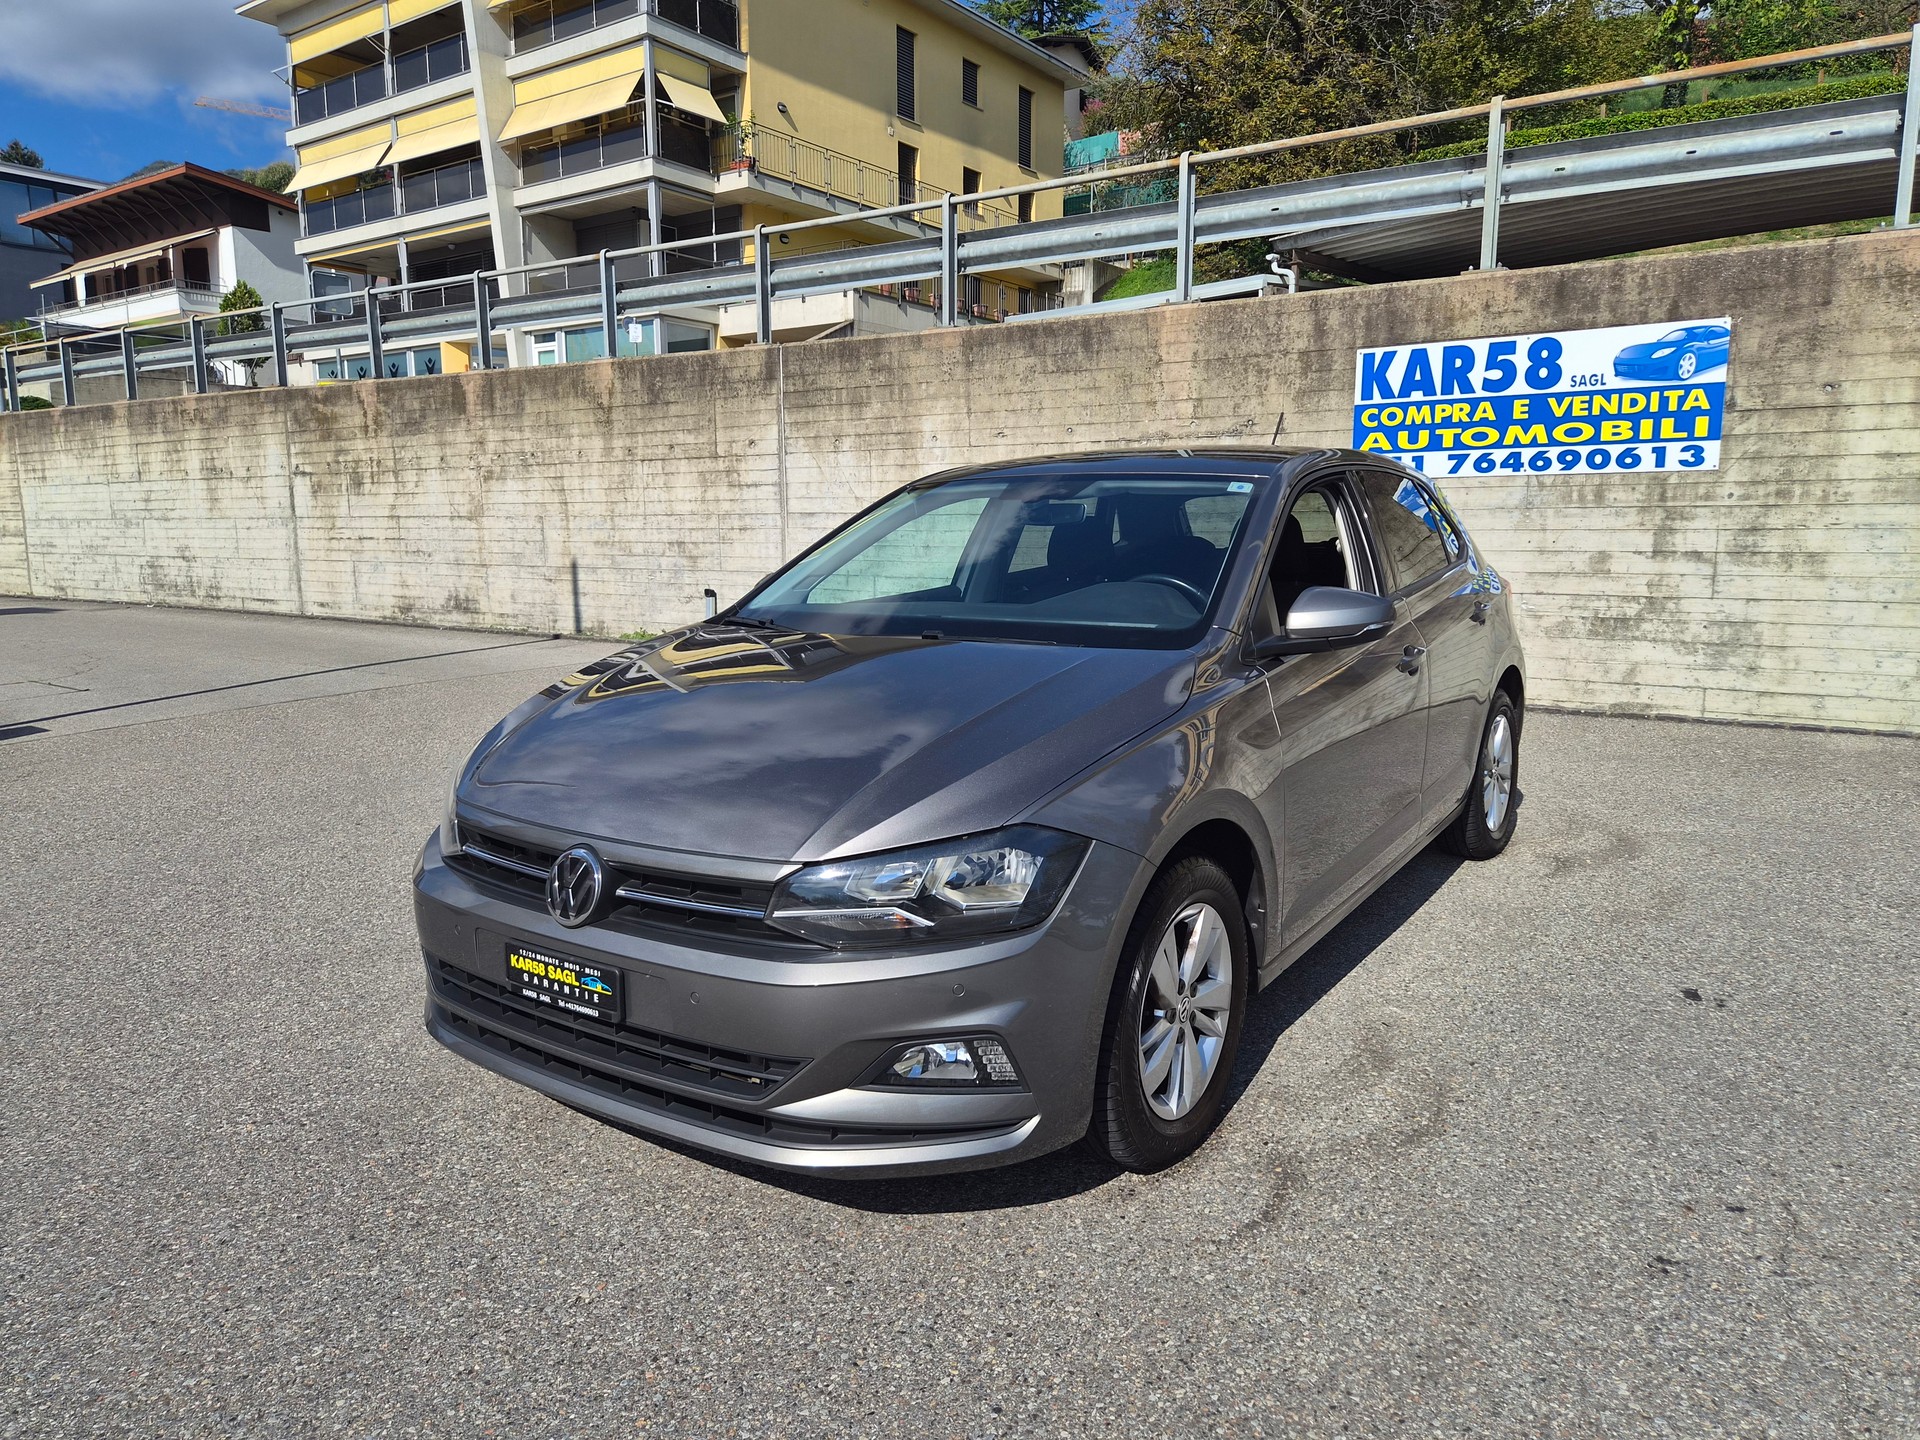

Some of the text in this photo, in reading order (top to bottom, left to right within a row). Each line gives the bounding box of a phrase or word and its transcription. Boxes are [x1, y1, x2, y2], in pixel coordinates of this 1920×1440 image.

[1361, 337, 1607, 401] KAR58 SAGL
[1361, 388, 1711, 428] COMPRA E VENDITA
[1359, 416, 1710, 452] AUTOMOBILI
[1447, 444, 1705, 475] 764690613
[510, 953, 580, 986] KAR58 SAGL
[519, 948, 536, 959] 12/24
[536, 953, 559, 966] MONATE
[564, 961, 580, 971] MOIS
[523, 972, 599, 1003] GARANTIE
